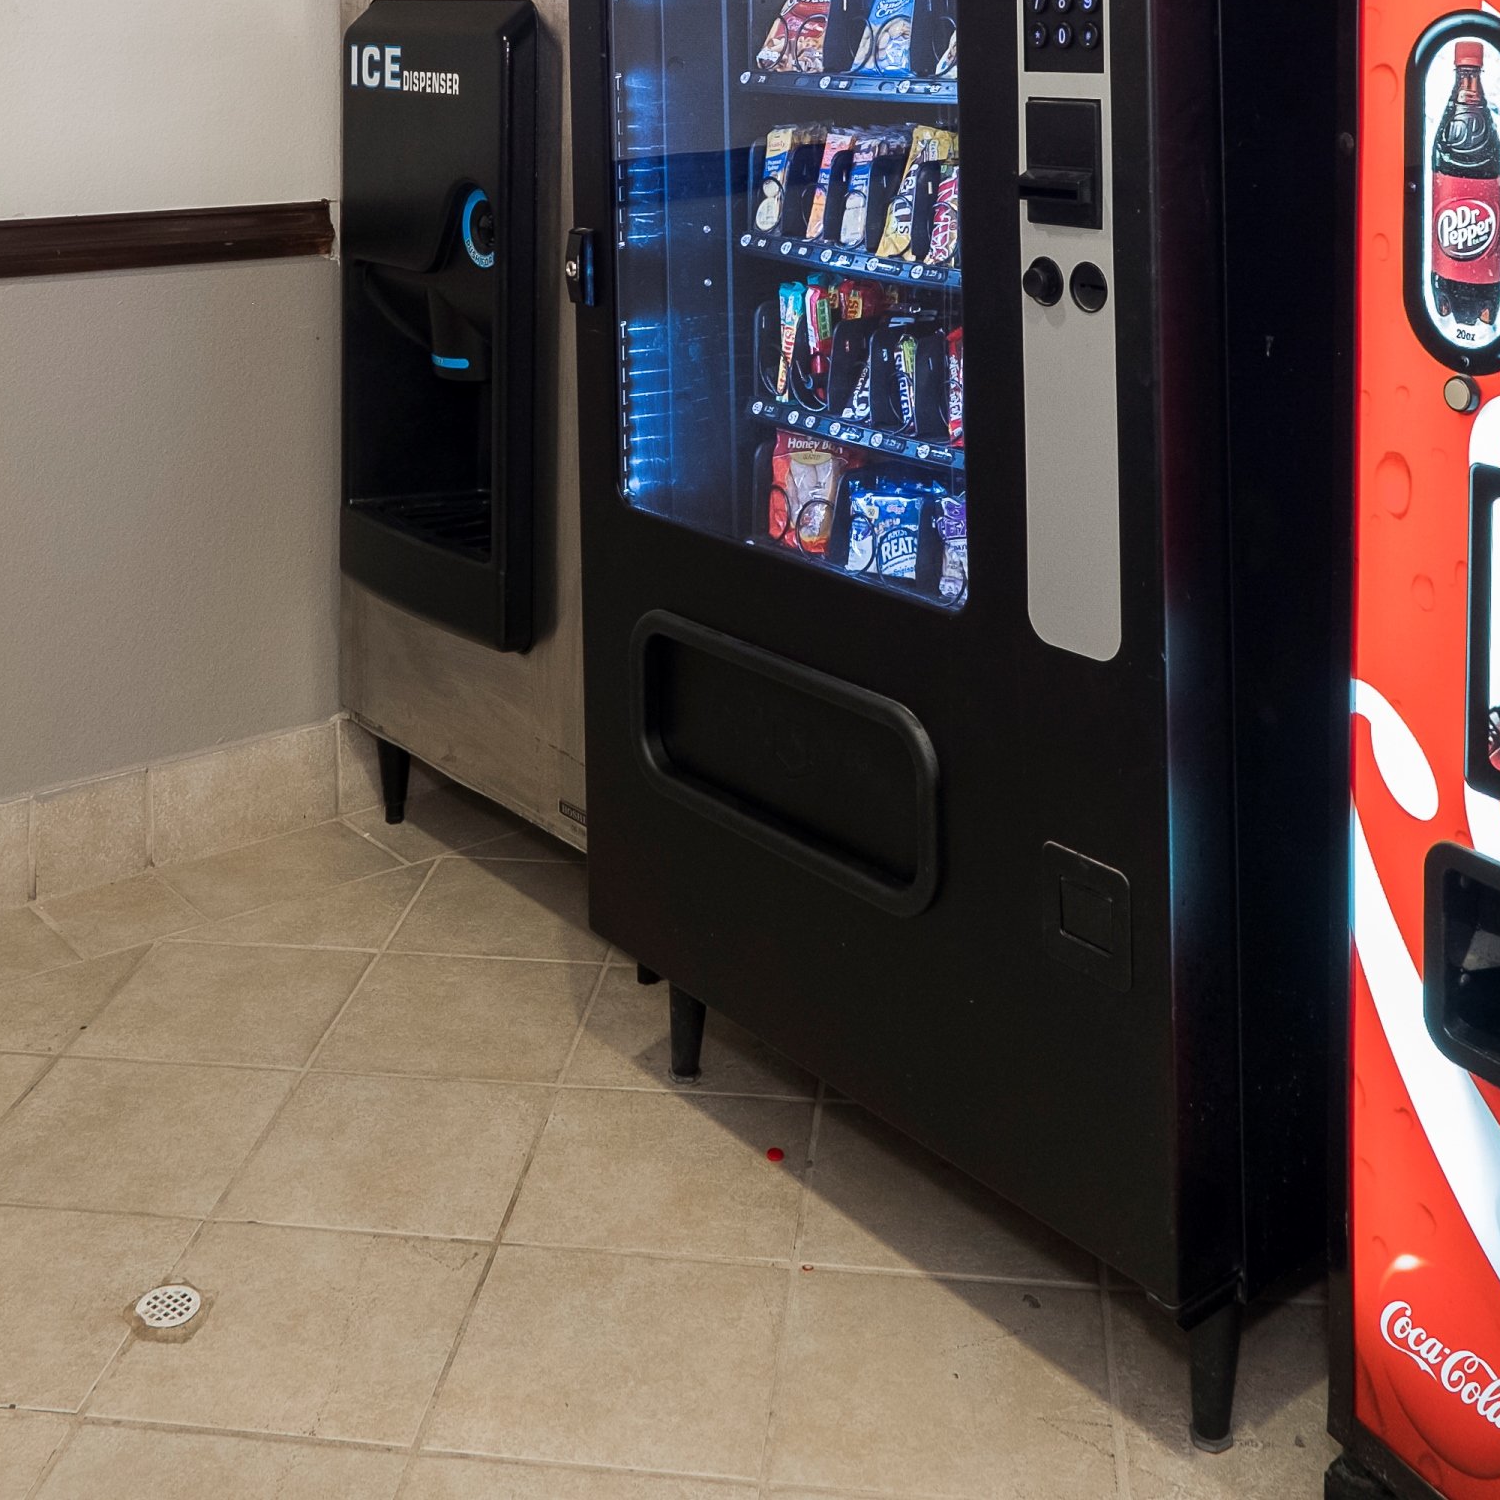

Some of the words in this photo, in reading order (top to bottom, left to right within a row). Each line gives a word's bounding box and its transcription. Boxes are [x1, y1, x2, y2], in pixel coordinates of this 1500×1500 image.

[1058, 28, 1066, 44] 0
[351, 44, 402, 89] ICE
[402, 70, 460, 95] DISPENSER
[1456, 205, 1481, 229] Dr
[1438, 209, 1493, 250] Pepper
[1456, 328, 1476, 342] 20oz
[787, 437, 820, 449] Honey
